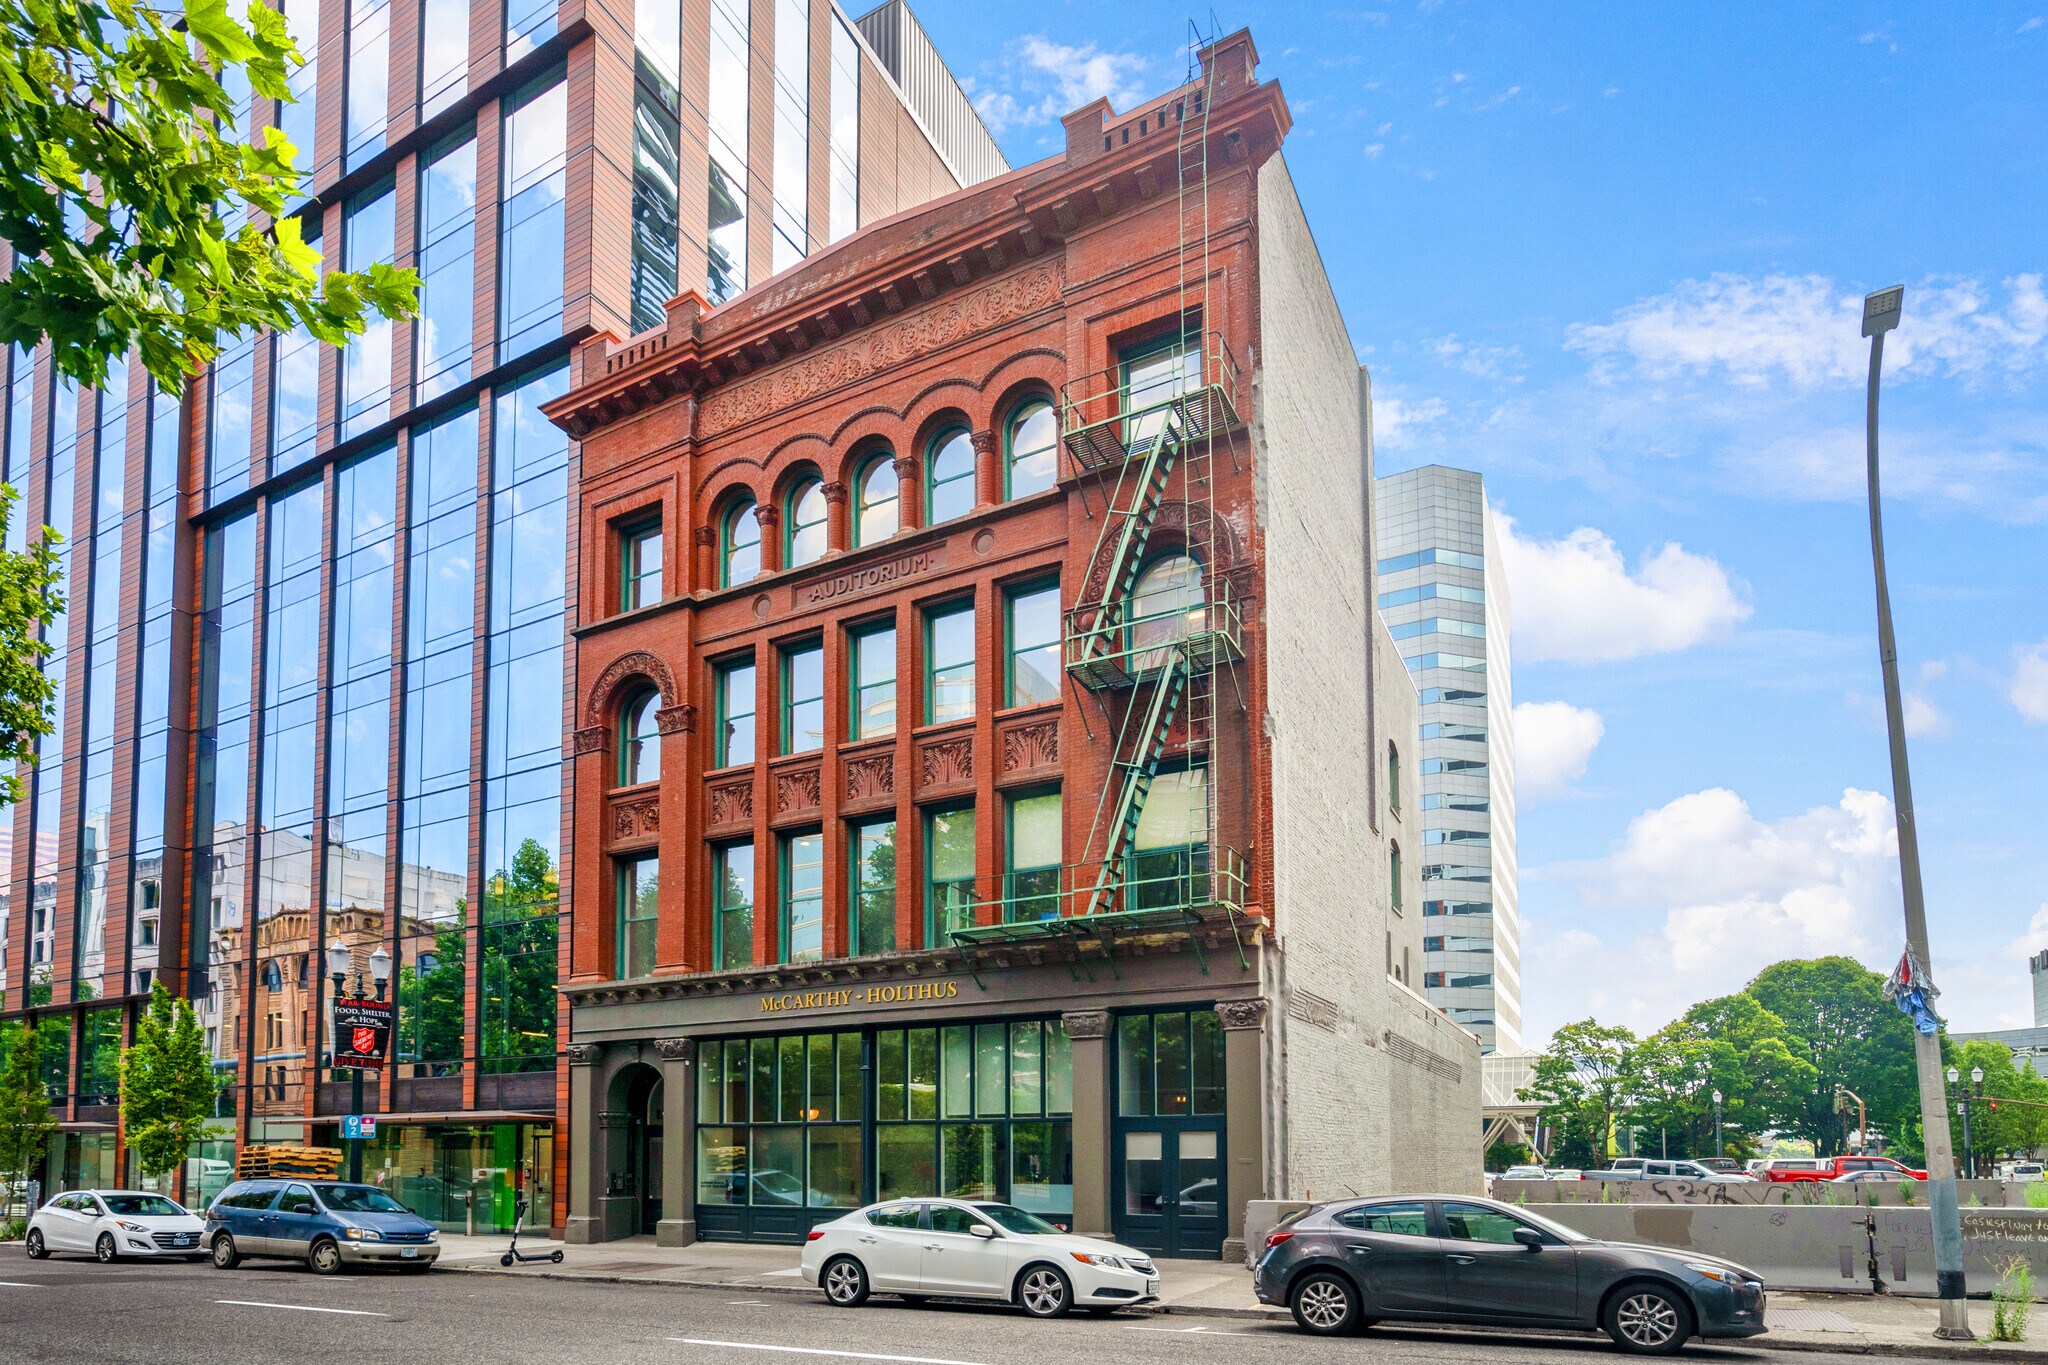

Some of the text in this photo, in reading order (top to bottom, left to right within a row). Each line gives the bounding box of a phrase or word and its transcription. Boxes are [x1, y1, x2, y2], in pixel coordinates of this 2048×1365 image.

[810, 553, 929, 603] AUDITORIUM
[760, 981, 958, 1012] McCARTHY HOLTHUS
[338, 999, 389, 1010] YEAR-ROUND
[361, 1008, 392, 1018] SHELTER,
[333, 1056, 357, 1066] GIVE
[350, 1126, 357, 1135] 2
